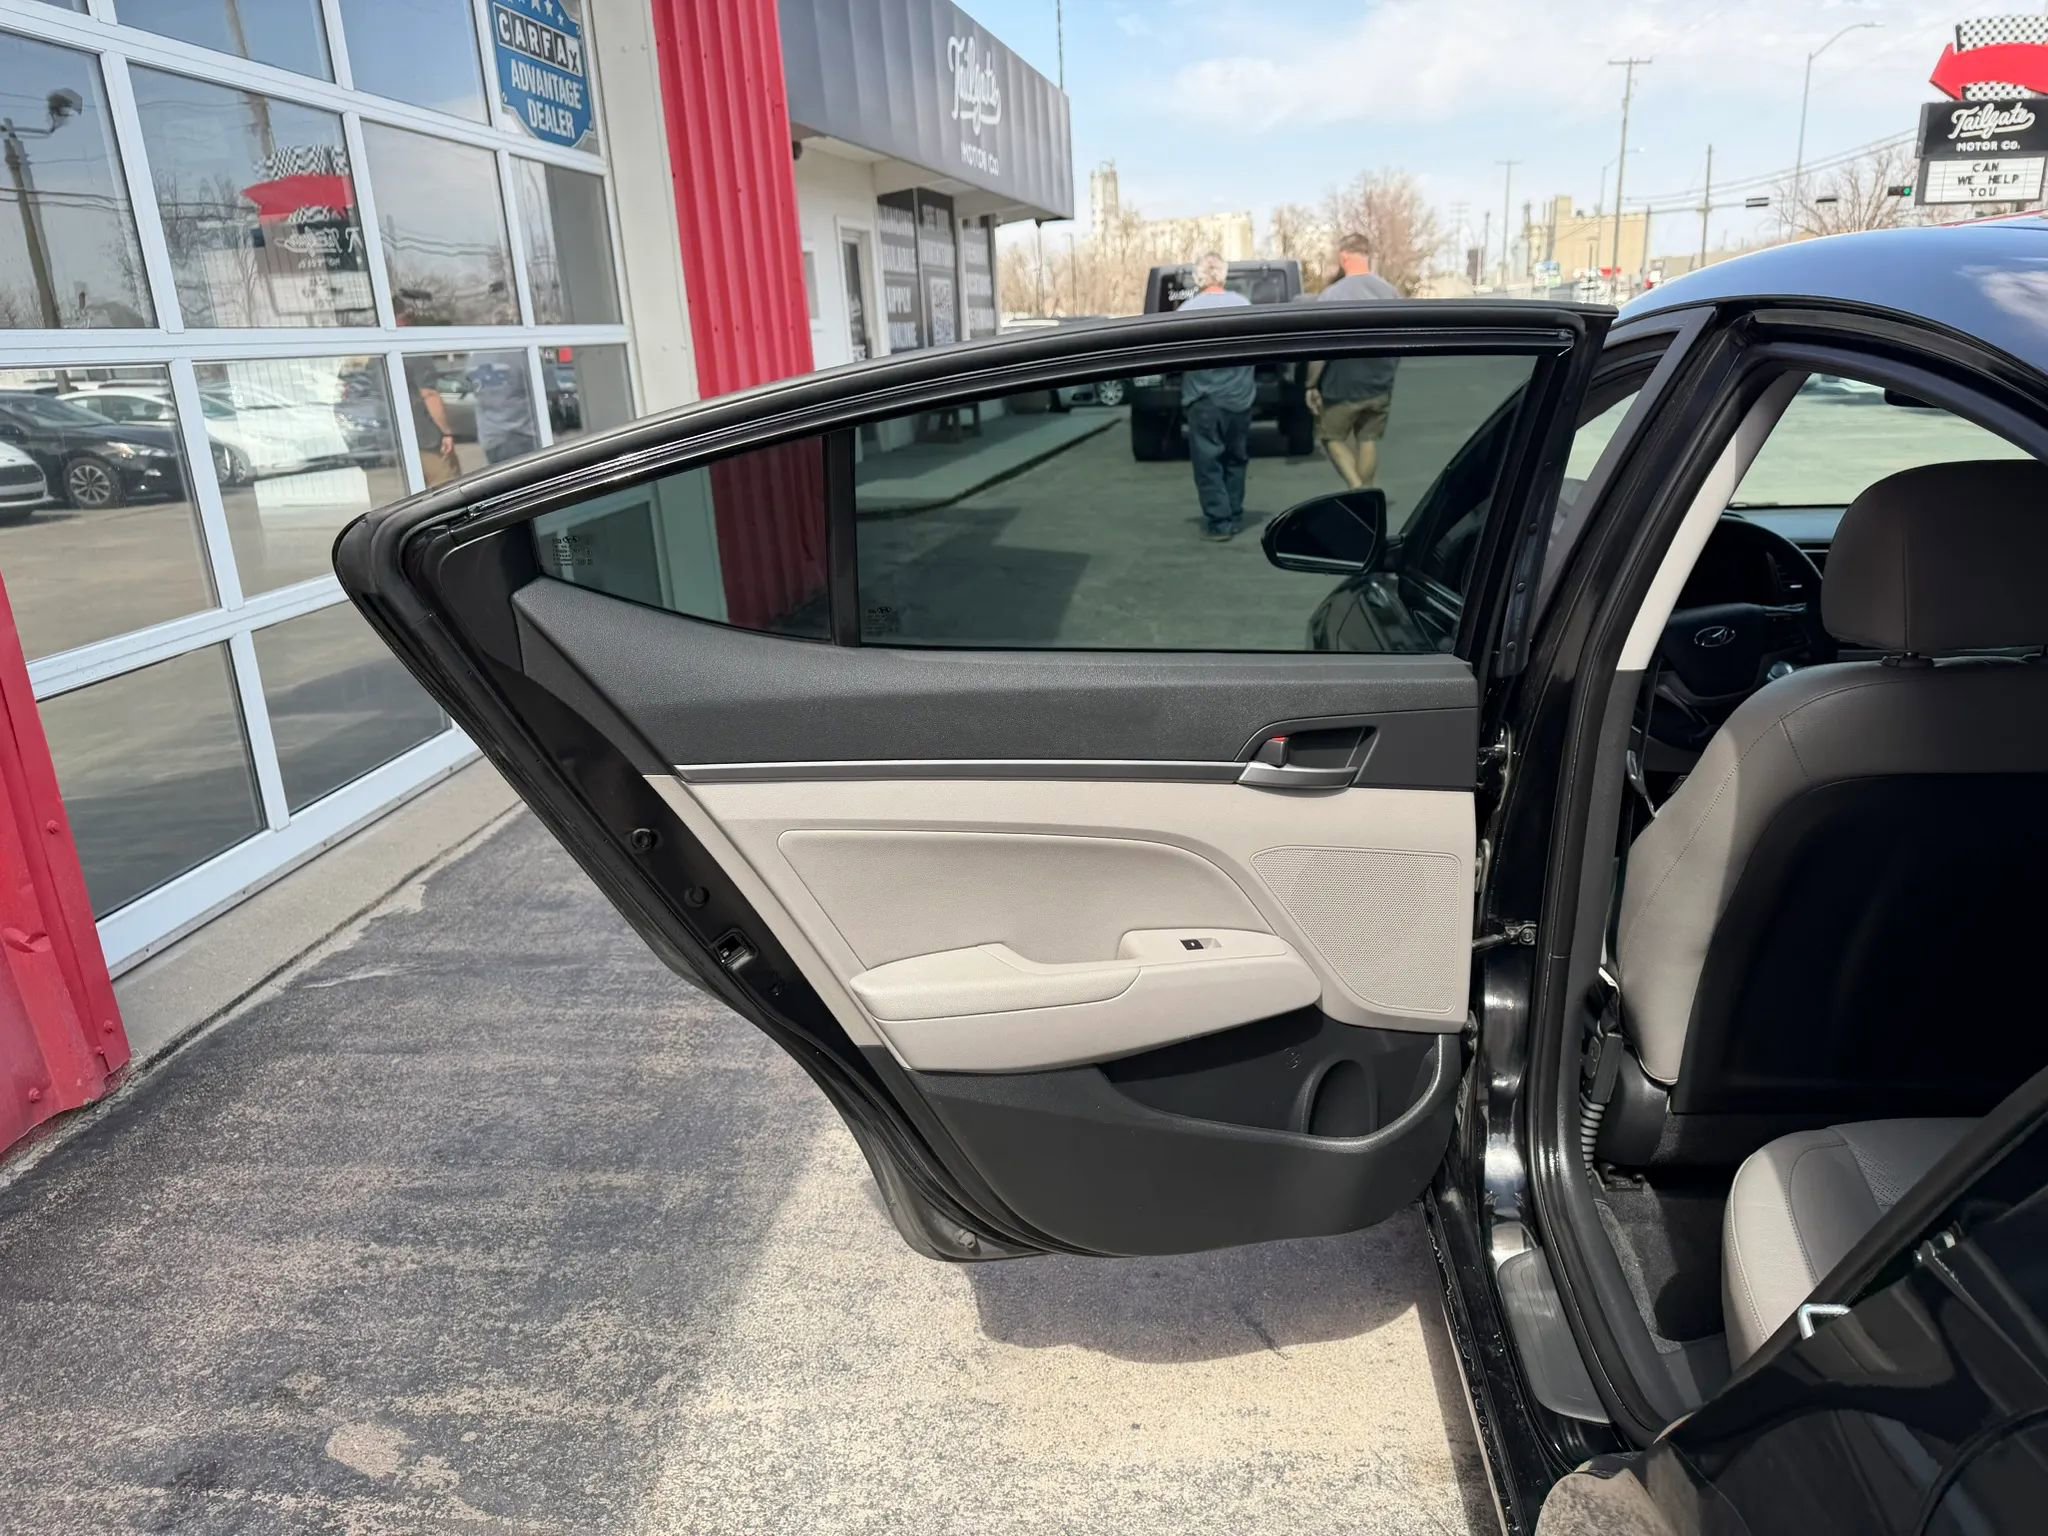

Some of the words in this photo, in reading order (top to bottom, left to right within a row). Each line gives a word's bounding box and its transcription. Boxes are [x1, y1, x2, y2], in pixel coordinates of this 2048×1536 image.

[498, 12, 578, 73] CARFAX
[510, 58, 582, 110] ADVANTAGE
[527, 98, 576, 139] DEALER
[1947, 101, 2036, 140] Tailgate
[960, 141, 987, 172] MOTOR
[1955, 140, 1998, 152] MOTOR
[1957, 175, 1975, 185] WE
[1987, 174, 2020, 185] HELP
[1972, 162, 2000, 173] CAN
[1968, 187, 1998, 197] YOU
